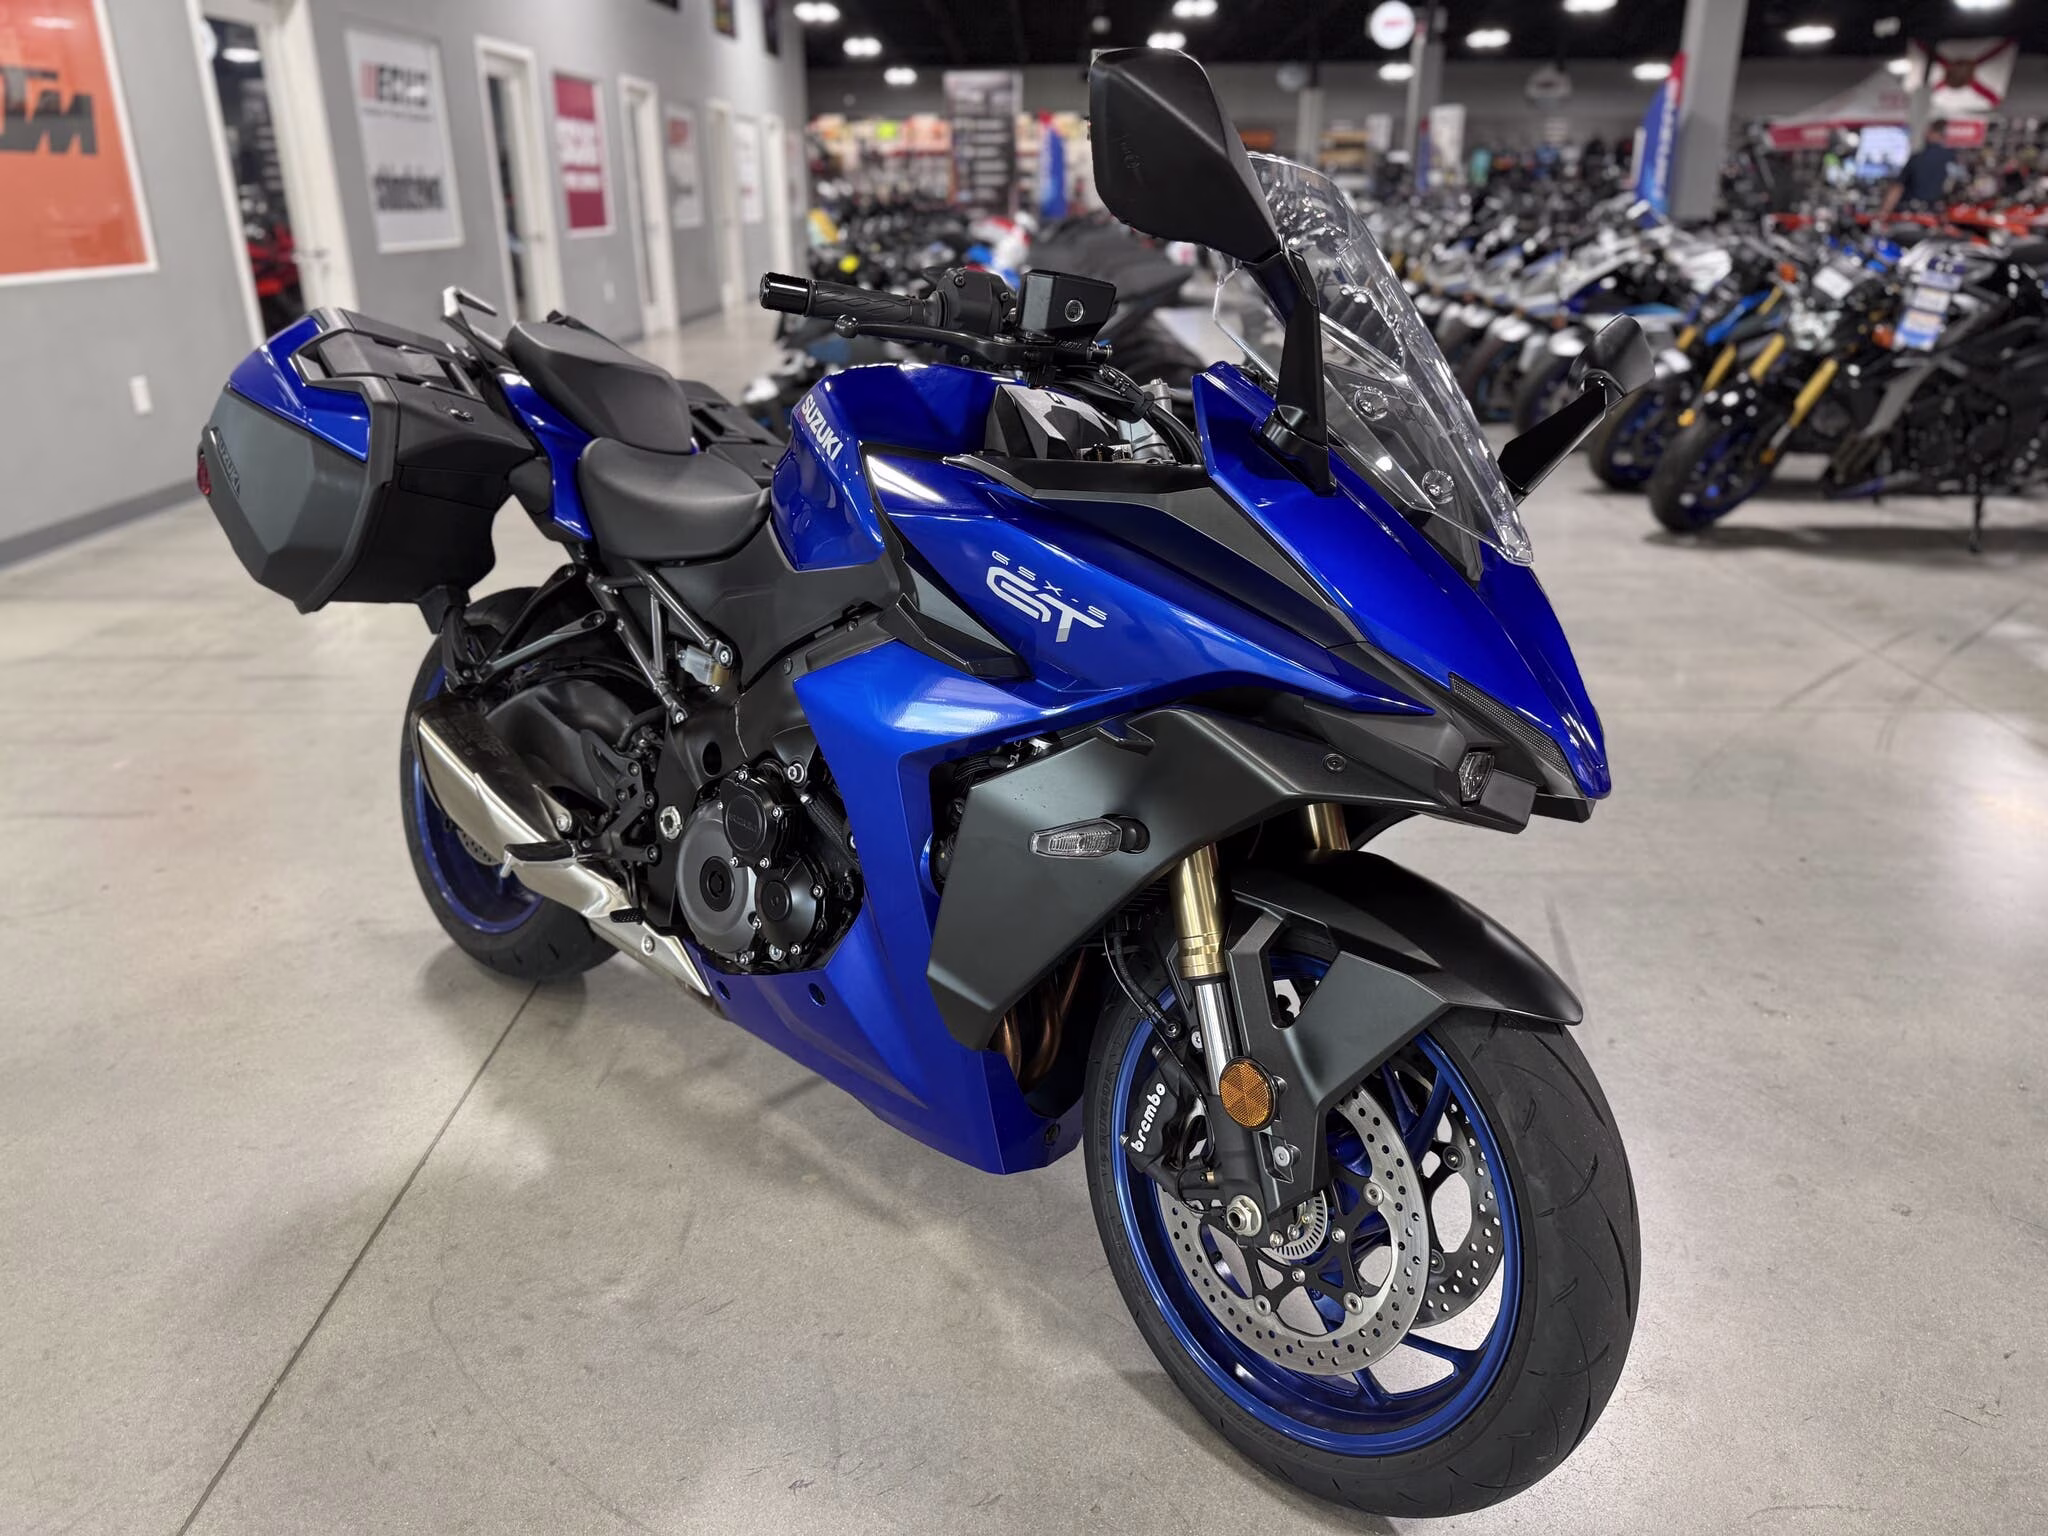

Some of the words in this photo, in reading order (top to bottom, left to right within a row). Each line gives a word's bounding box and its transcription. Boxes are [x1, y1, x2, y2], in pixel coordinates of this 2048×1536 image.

[0, 66, 97, 155] TM
[801, 393, 844, 461] SUZUKI
[986, 566, 1105, 643] GT
[991, 550, 1108, 620] GSX-S
[1130, 1083, 1166, 1152] brembo
